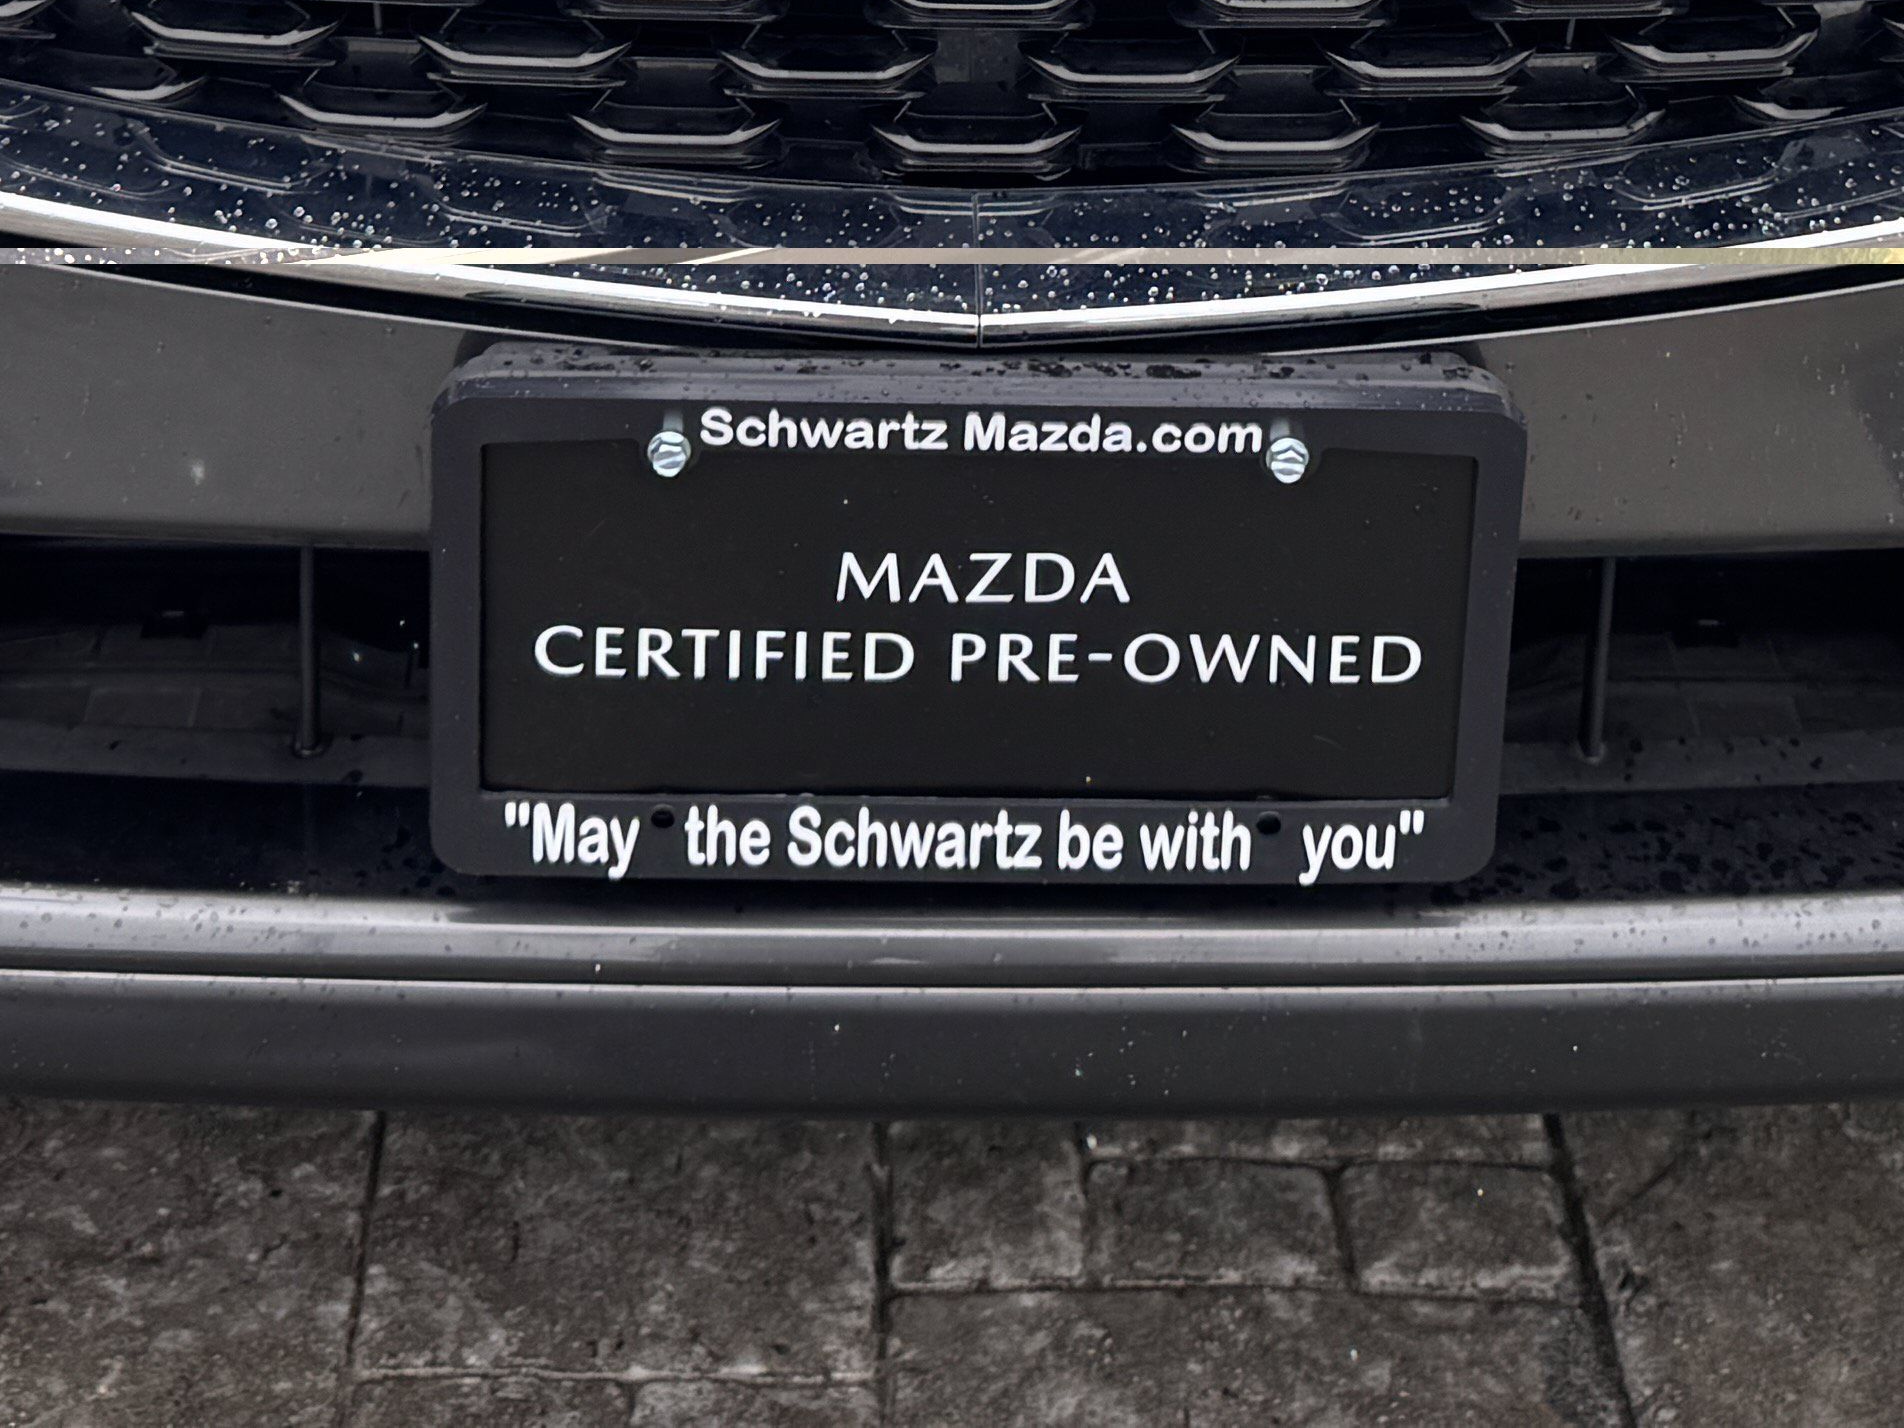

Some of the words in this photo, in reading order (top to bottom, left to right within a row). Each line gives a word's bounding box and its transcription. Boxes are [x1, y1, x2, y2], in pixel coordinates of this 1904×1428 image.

[699, 407, 949, 451] Schwartz
[963, 411, 1264, 455] Mazda.com
[835, 551, 1132, 605] MAZDA
[533, 624, 916, 682] CERTIFIED
[949, 631, 1423, 685] PRE-OWNED
[503, 801, 641, 880] "May
[684, 804, 772, 867] the
[786, 804, 1043, 871] Schwartz
[1056, 808, 1124, 871] be
[1138, 808, 1252, 872] with
[1297, 809, 1426, 887] you"
